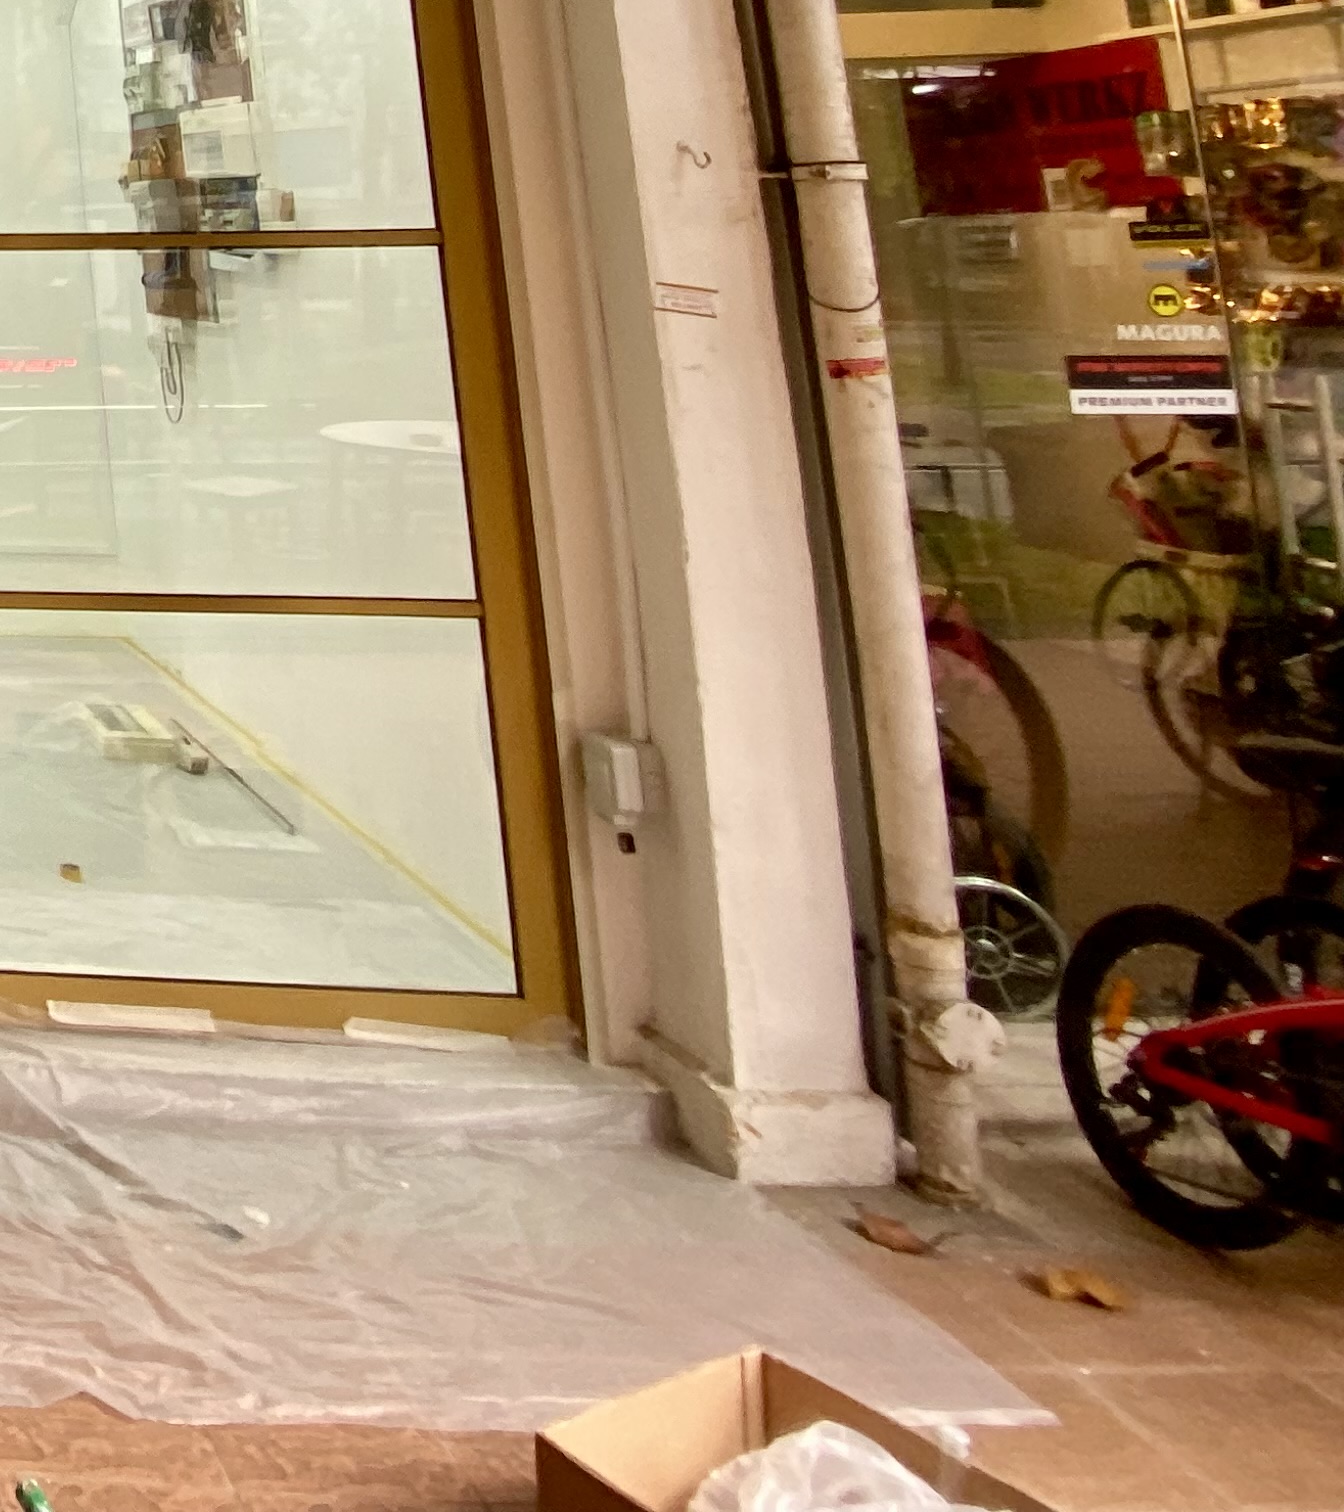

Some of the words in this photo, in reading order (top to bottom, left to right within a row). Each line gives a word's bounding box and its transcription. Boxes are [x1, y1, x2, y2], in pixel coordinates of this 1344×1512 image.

[1116, 324, 1222, 341] MAGURA
[1078, 396, 1152, 407] PREMIUM
[1157, 396, 1228, 407] PARTNER
